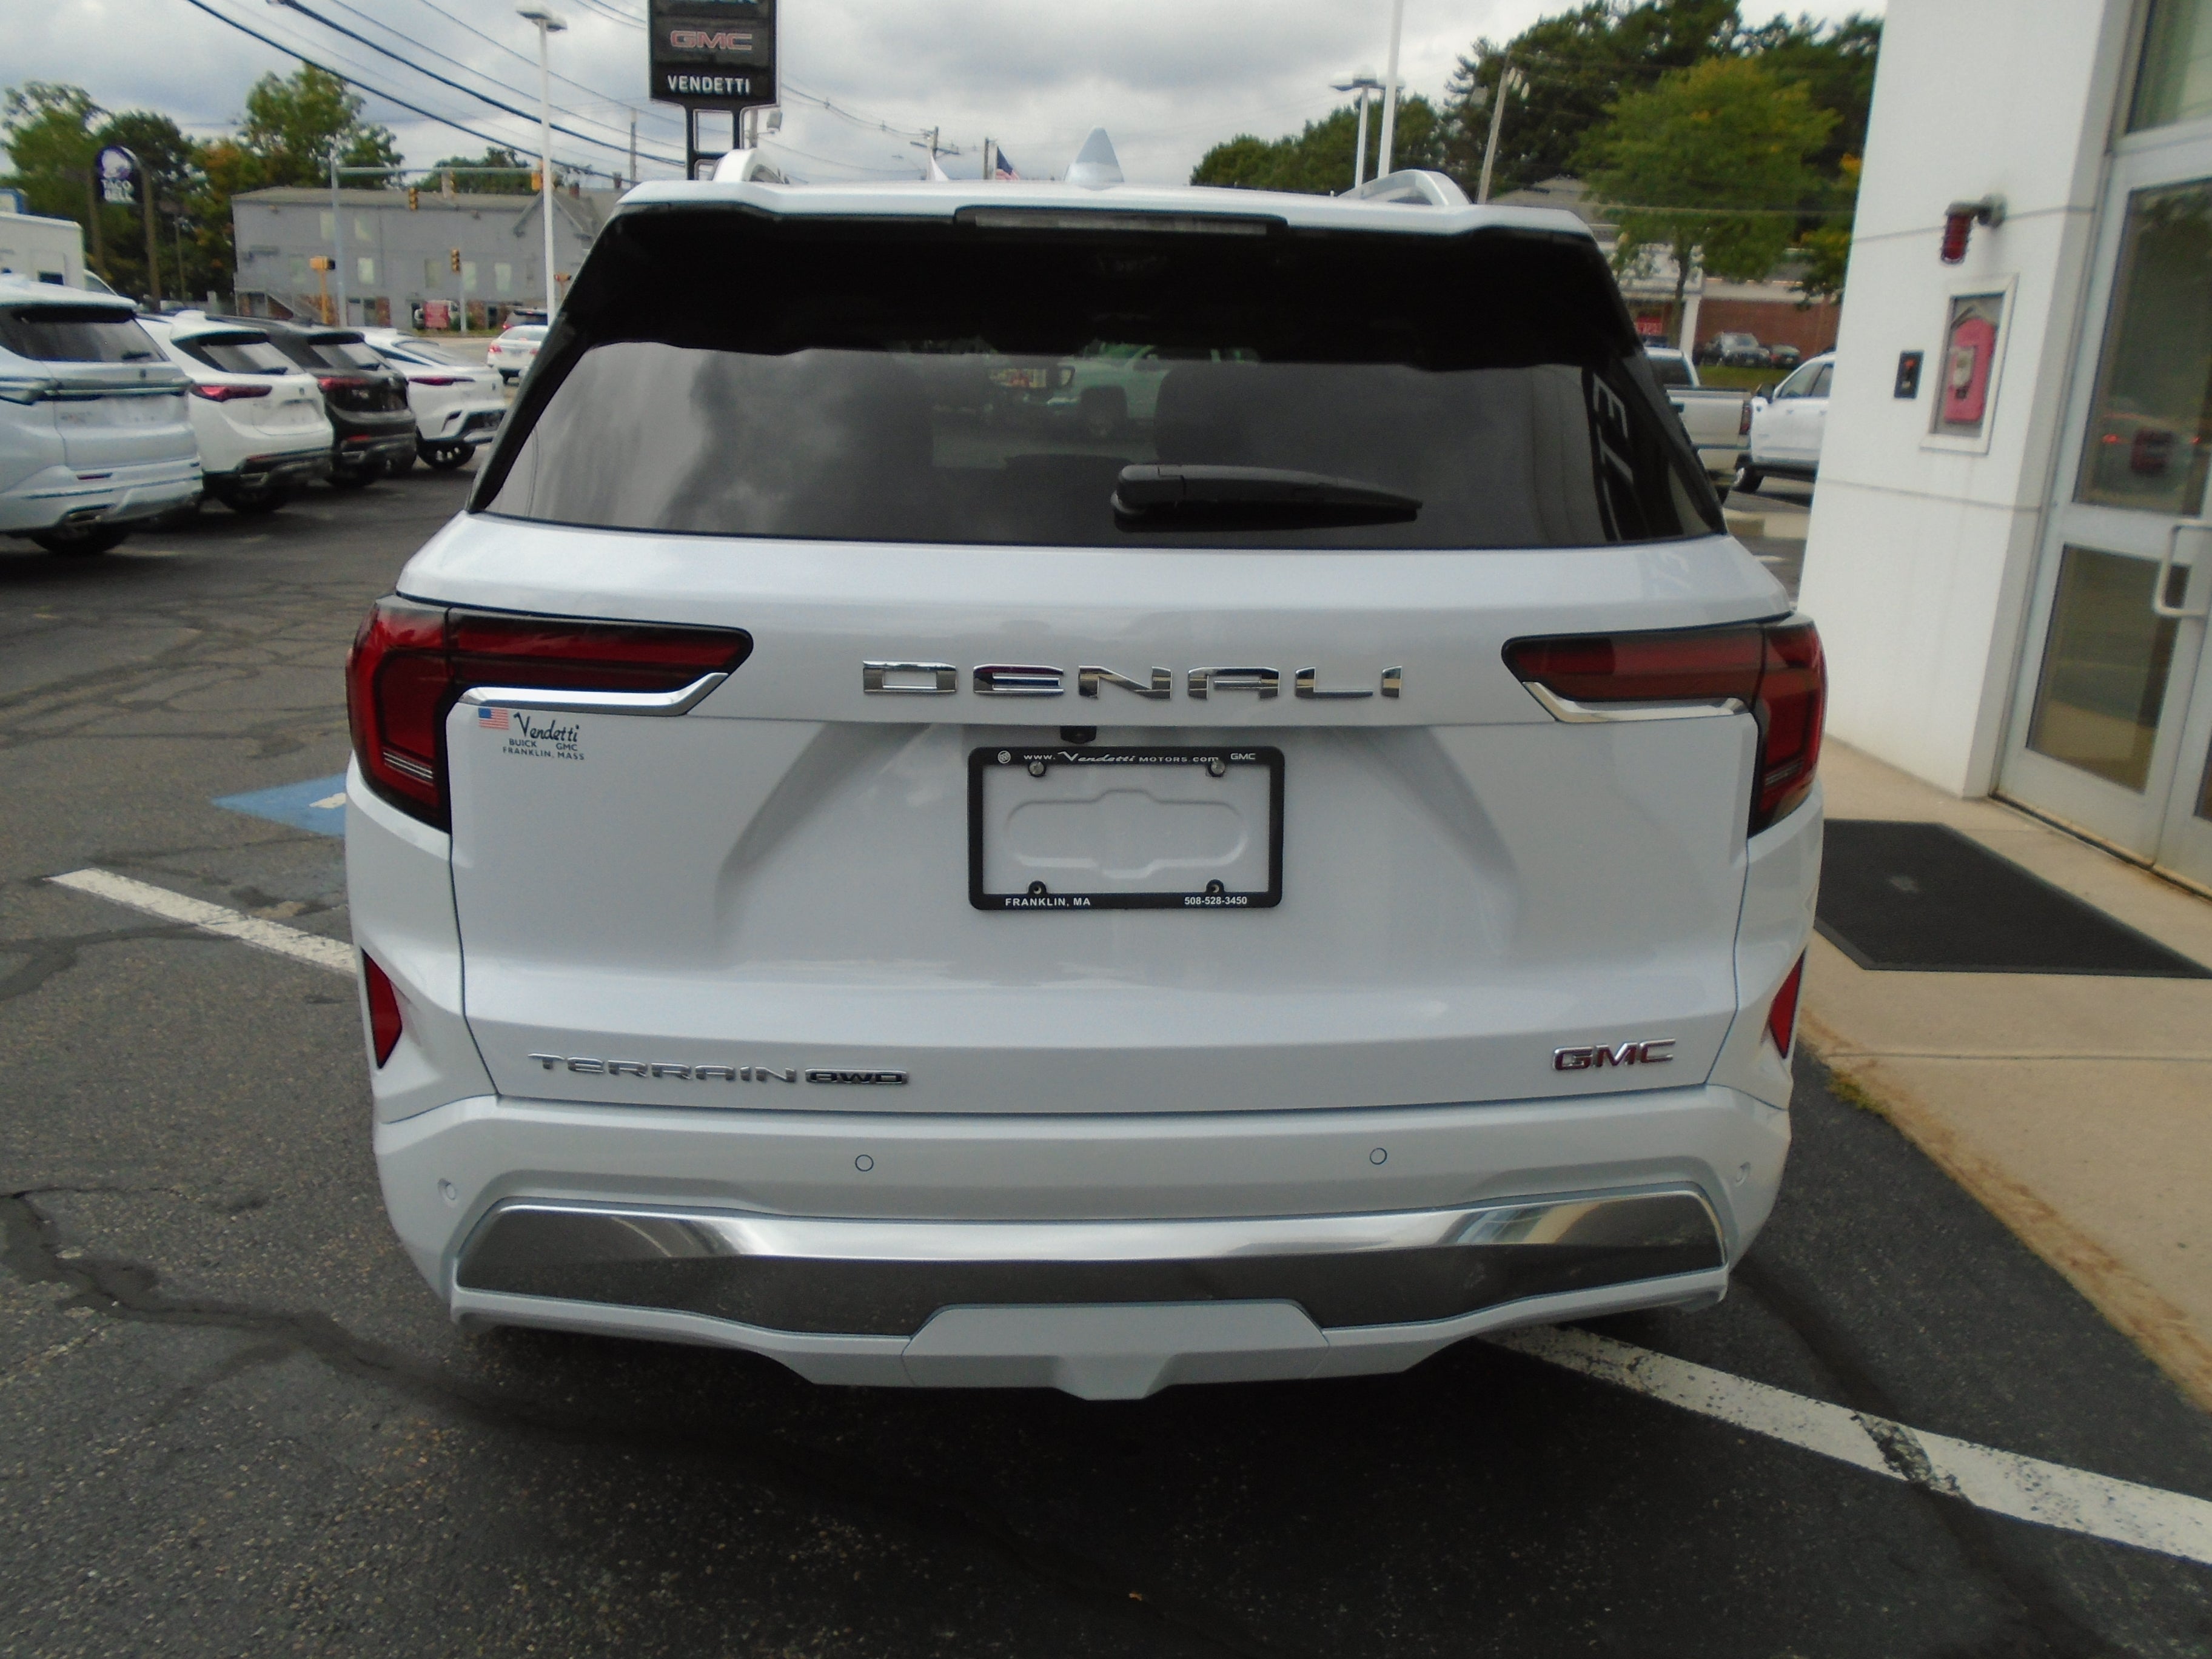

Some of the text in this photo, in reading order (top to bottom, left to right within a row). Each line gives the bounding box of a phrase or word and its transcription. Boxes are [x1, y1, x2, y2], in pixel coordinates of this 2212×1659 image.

[670, 30, 752, 50] GMC
[667, 75, 750, 95] VENDETTI
[101, 178, 133, 193] TACO
[862, 660, 1403, 699] DENALI
[513, 712, 580, 742] Vendetti
[509, 738, 578, 751] BUICK GMC
[1005, 897, 1091, 907] FRANKLIN, MA
[1184, 896, 1247, 905] 508-528-3450
[1552, 1038, 1676, 1070] GMC
[527, 1053, 906, 1085] TERRAIN AWD
